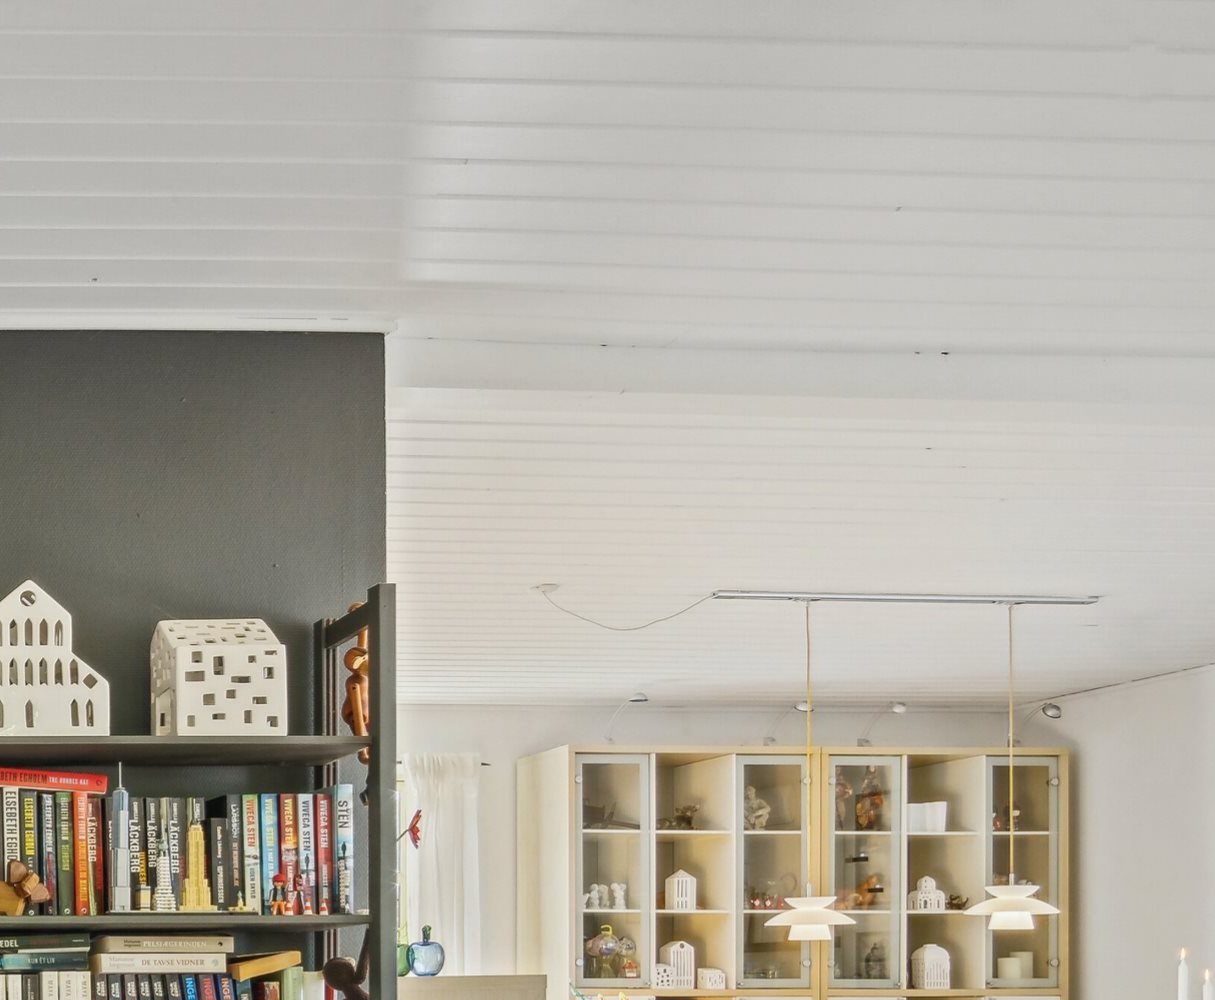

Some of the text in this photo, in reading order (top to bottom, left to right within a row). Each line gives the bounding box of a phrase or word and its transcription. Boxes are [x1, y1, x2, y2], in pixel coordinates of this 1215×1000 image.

[5, 791, 17, 834] ELSEBETH
[246, 800, 256, 847] VIVECA STEN
[301, 801, 311, 852] VIVECA STEN
[320, 800, 328, 827] VIVECA
[337, 800, 349, 829] STEN
[87, 816, 97, 862] LÄCKBERG
[128, 820, 141, 873] LÄCKBERG
[147, 820, 157, 868] LÄCKBERG
[169, 820, 180, 874] LÄCKBERG
